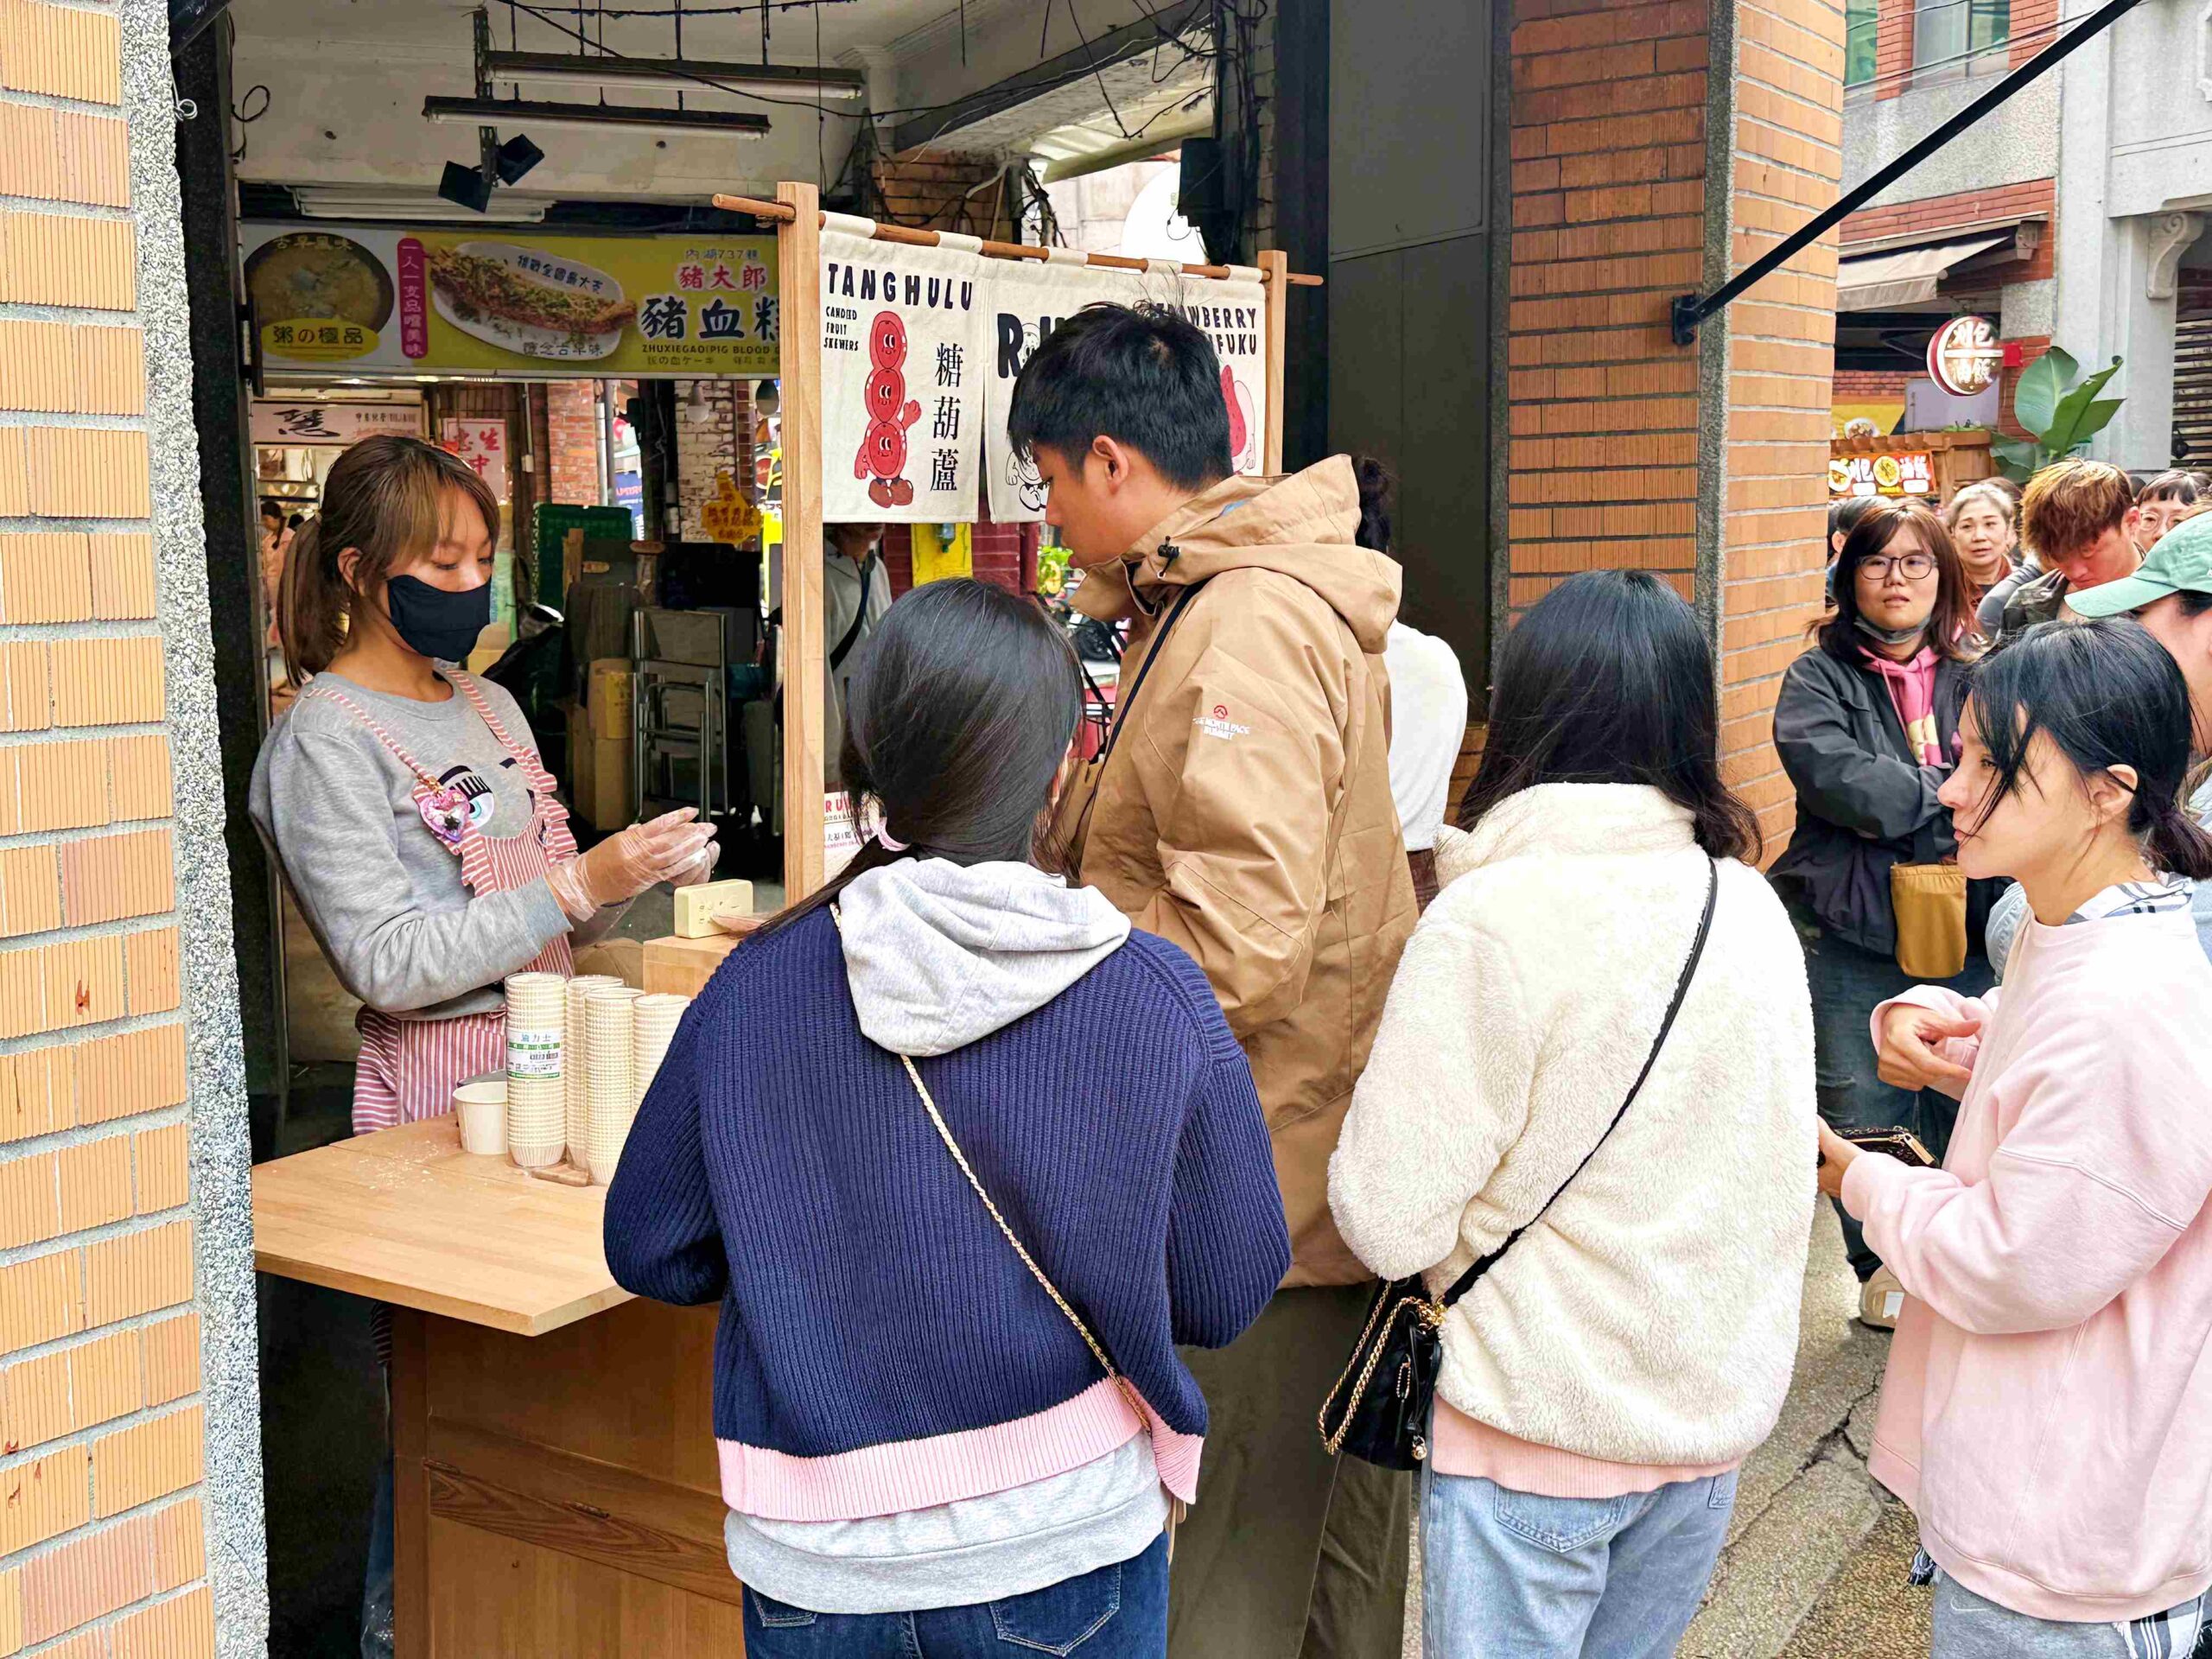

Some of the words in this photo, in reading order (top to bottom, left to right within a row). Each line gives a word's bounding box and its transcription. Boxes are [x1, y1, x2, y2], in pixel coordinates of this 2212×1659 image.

[678, 264, 766, 290] 豬大郎
[828, 263, 973, 311] TANGHULU
[825, 306, 857, 321] CANDIED
[273, 326, 364, 345] 粥の極品
[826, 322, 848, 335] FRUIT
[733, 346, 770, 354] BLOOD
[823, 337, 859, 352] SKEWERS
[930, 342, 963, 493] 糖葫蘆
